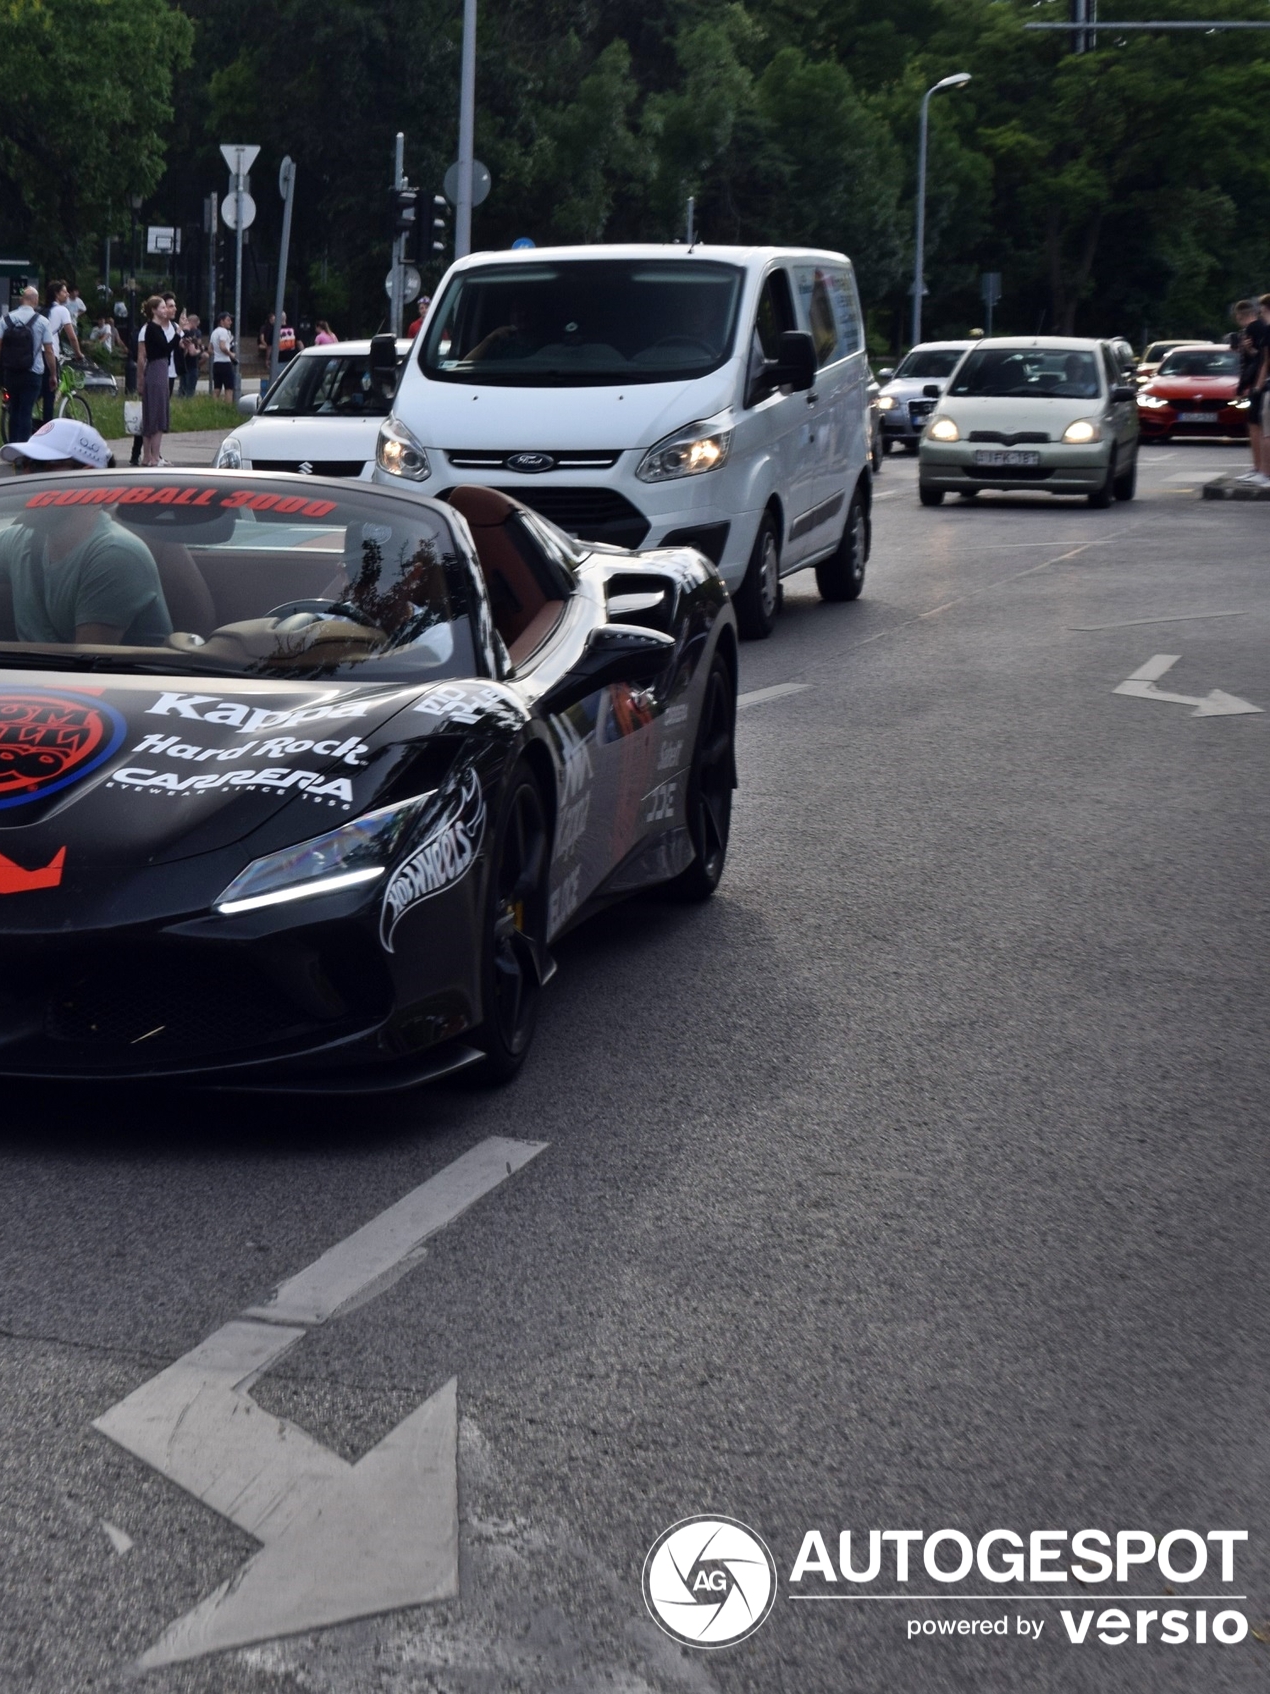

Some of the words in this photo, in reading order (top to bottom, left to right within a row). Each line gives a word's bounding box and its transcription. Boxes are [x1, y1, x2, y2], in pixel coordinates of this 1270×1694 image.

[26, 486, 218, 509] GUMBALL
[220, 490, 337, 518] 3000
[144, 691, 372, 733] Kappa
[132, 734, 259, 762] Hard
[252, 736, 370, 766] Rock
[105, 781, 205, 797] EYEWEAR
[221, 785, 286, 796] SINCE
[301, 793, 352, 811] 1956
[112, 767, 354, 802] CARRERA
